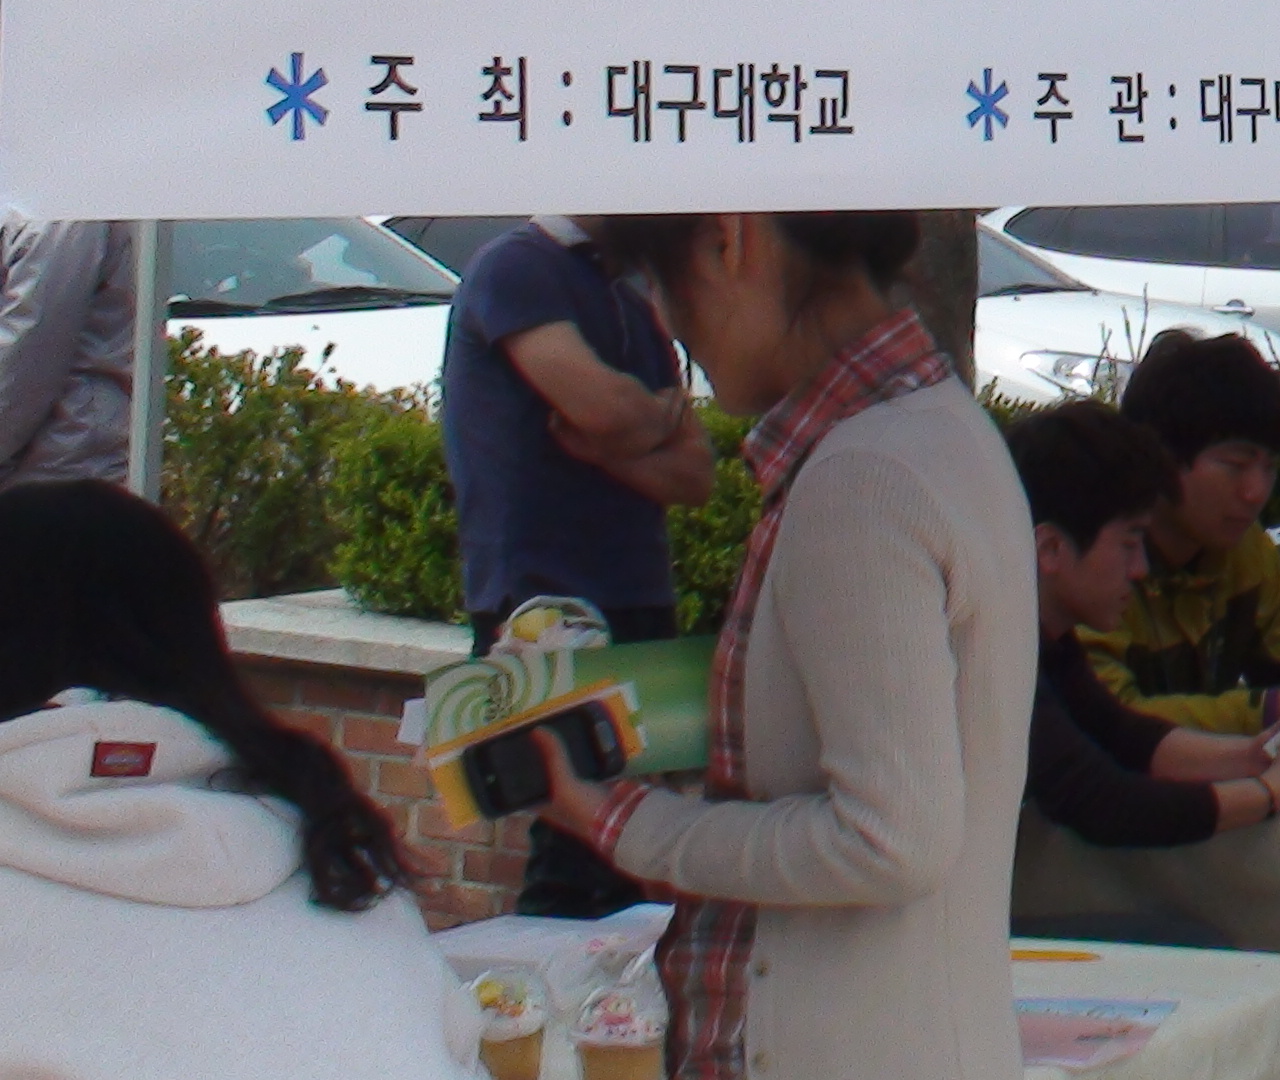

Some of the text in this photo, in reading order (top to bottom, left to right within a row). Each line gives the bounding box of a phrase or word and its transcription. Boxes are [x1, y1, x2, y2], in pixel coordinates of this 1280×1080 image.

[364, 54, 423, 141] 주
[478, 55, 529, 142] 최
[605, 59, 855, 144] 대구대학교
[1033, 71, 1074, 145] 주
[1108, 71, 1149, 144] 관
